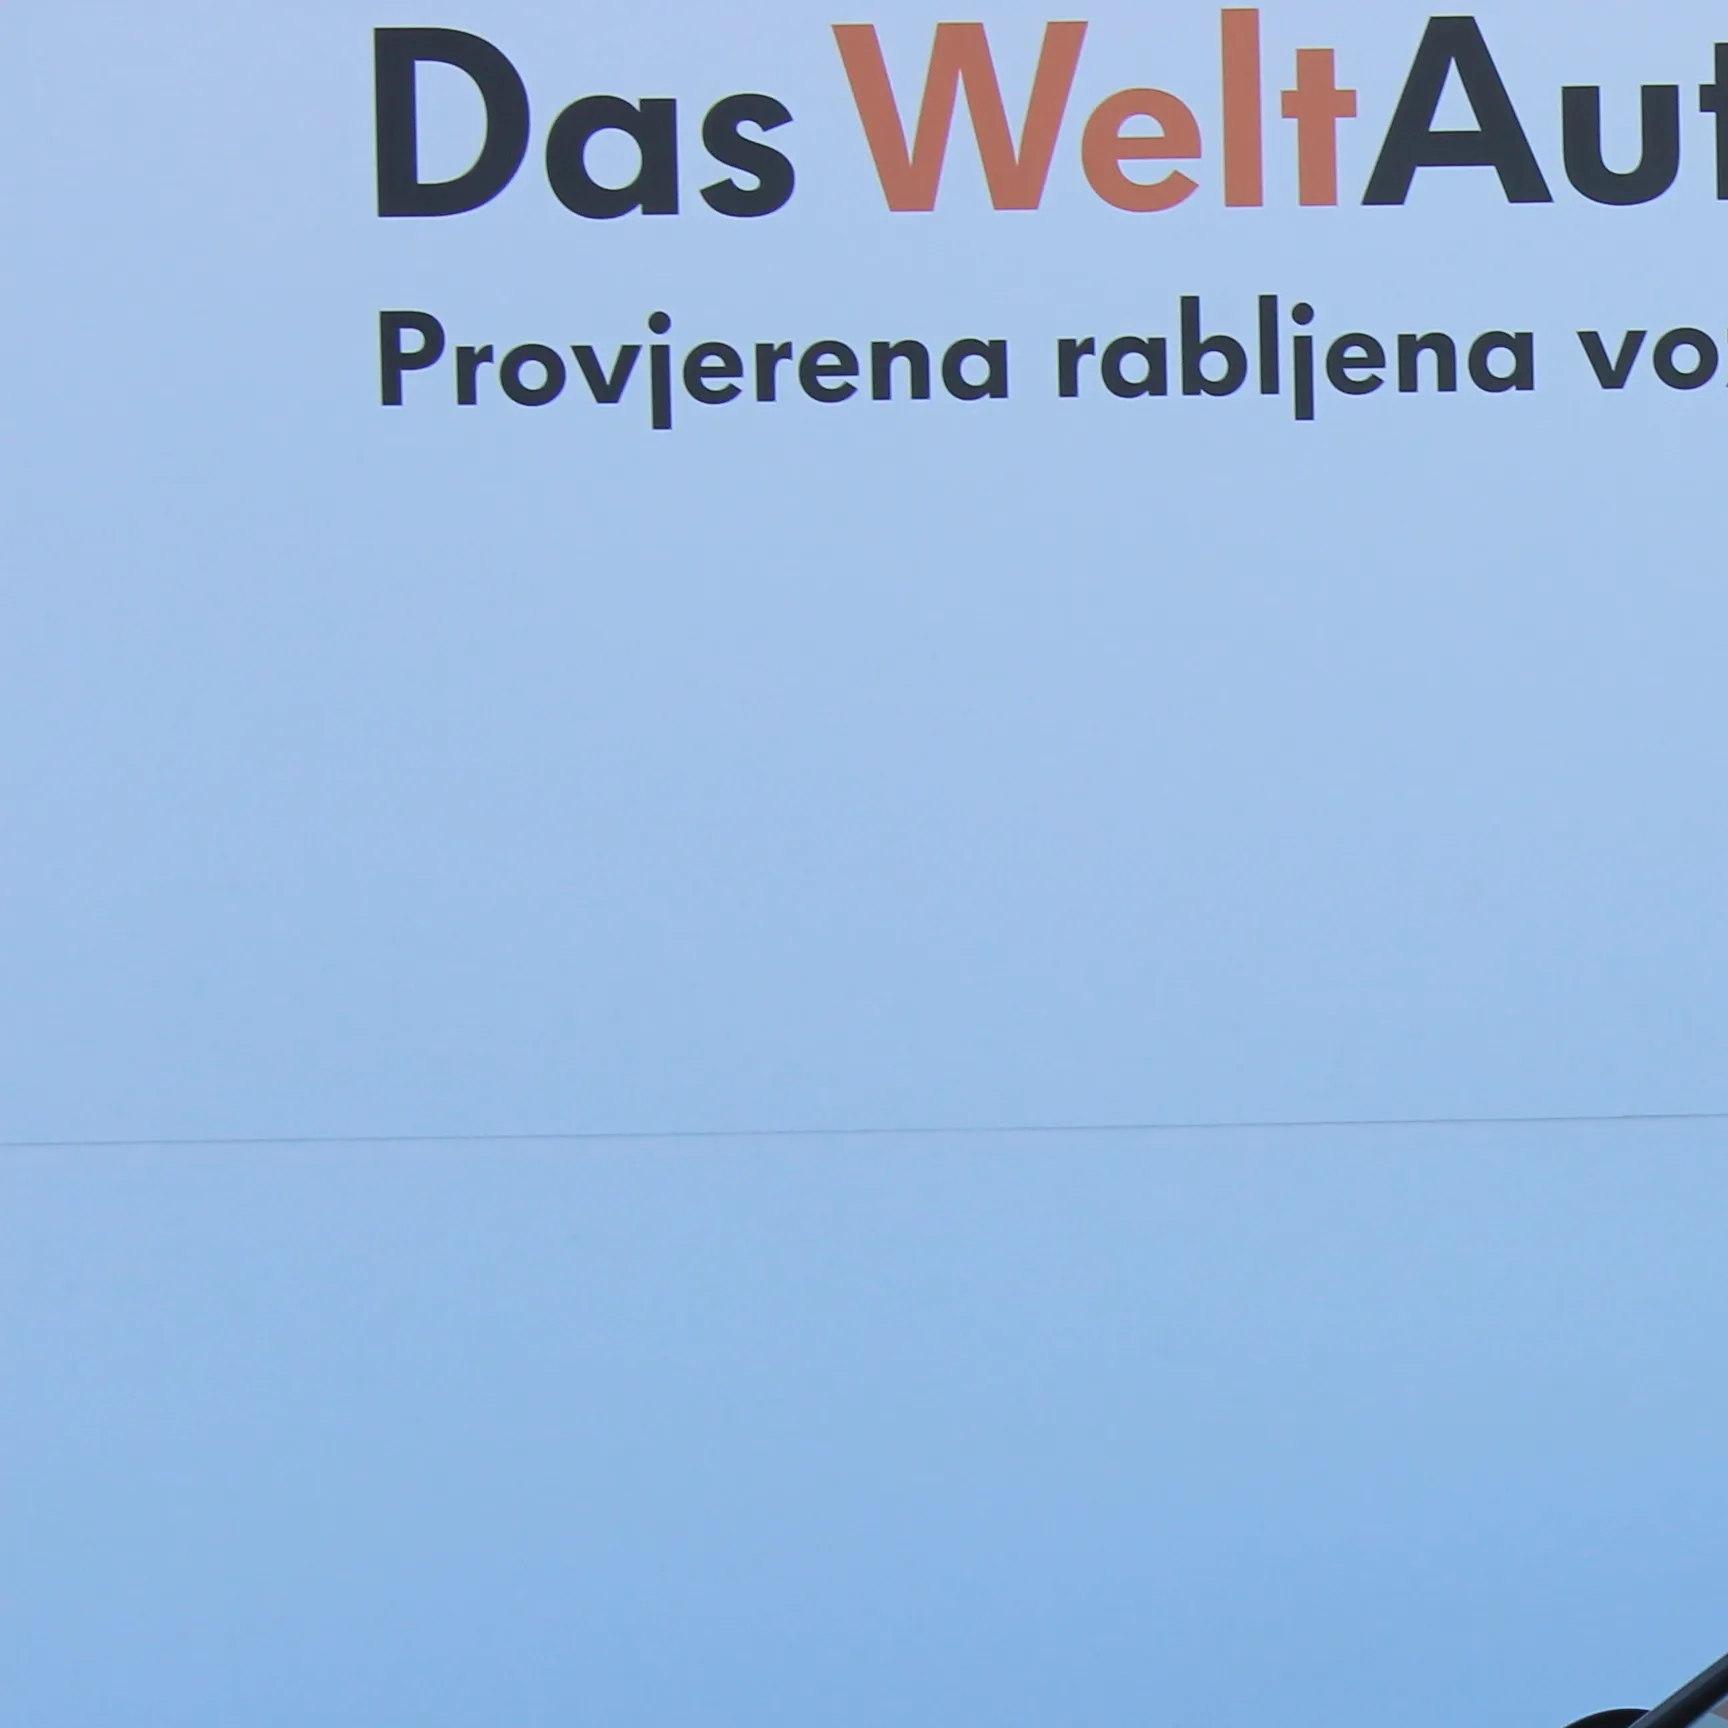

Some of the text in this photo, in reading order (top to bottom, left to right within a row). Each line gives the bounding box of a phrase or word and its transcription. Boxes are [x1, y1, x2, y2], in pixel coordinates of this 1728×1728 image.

[372, 26, 796, 219] Das
[378, 309, 1009, 430] Provjerena
[1056, 293, 1536, 421] rabljena
